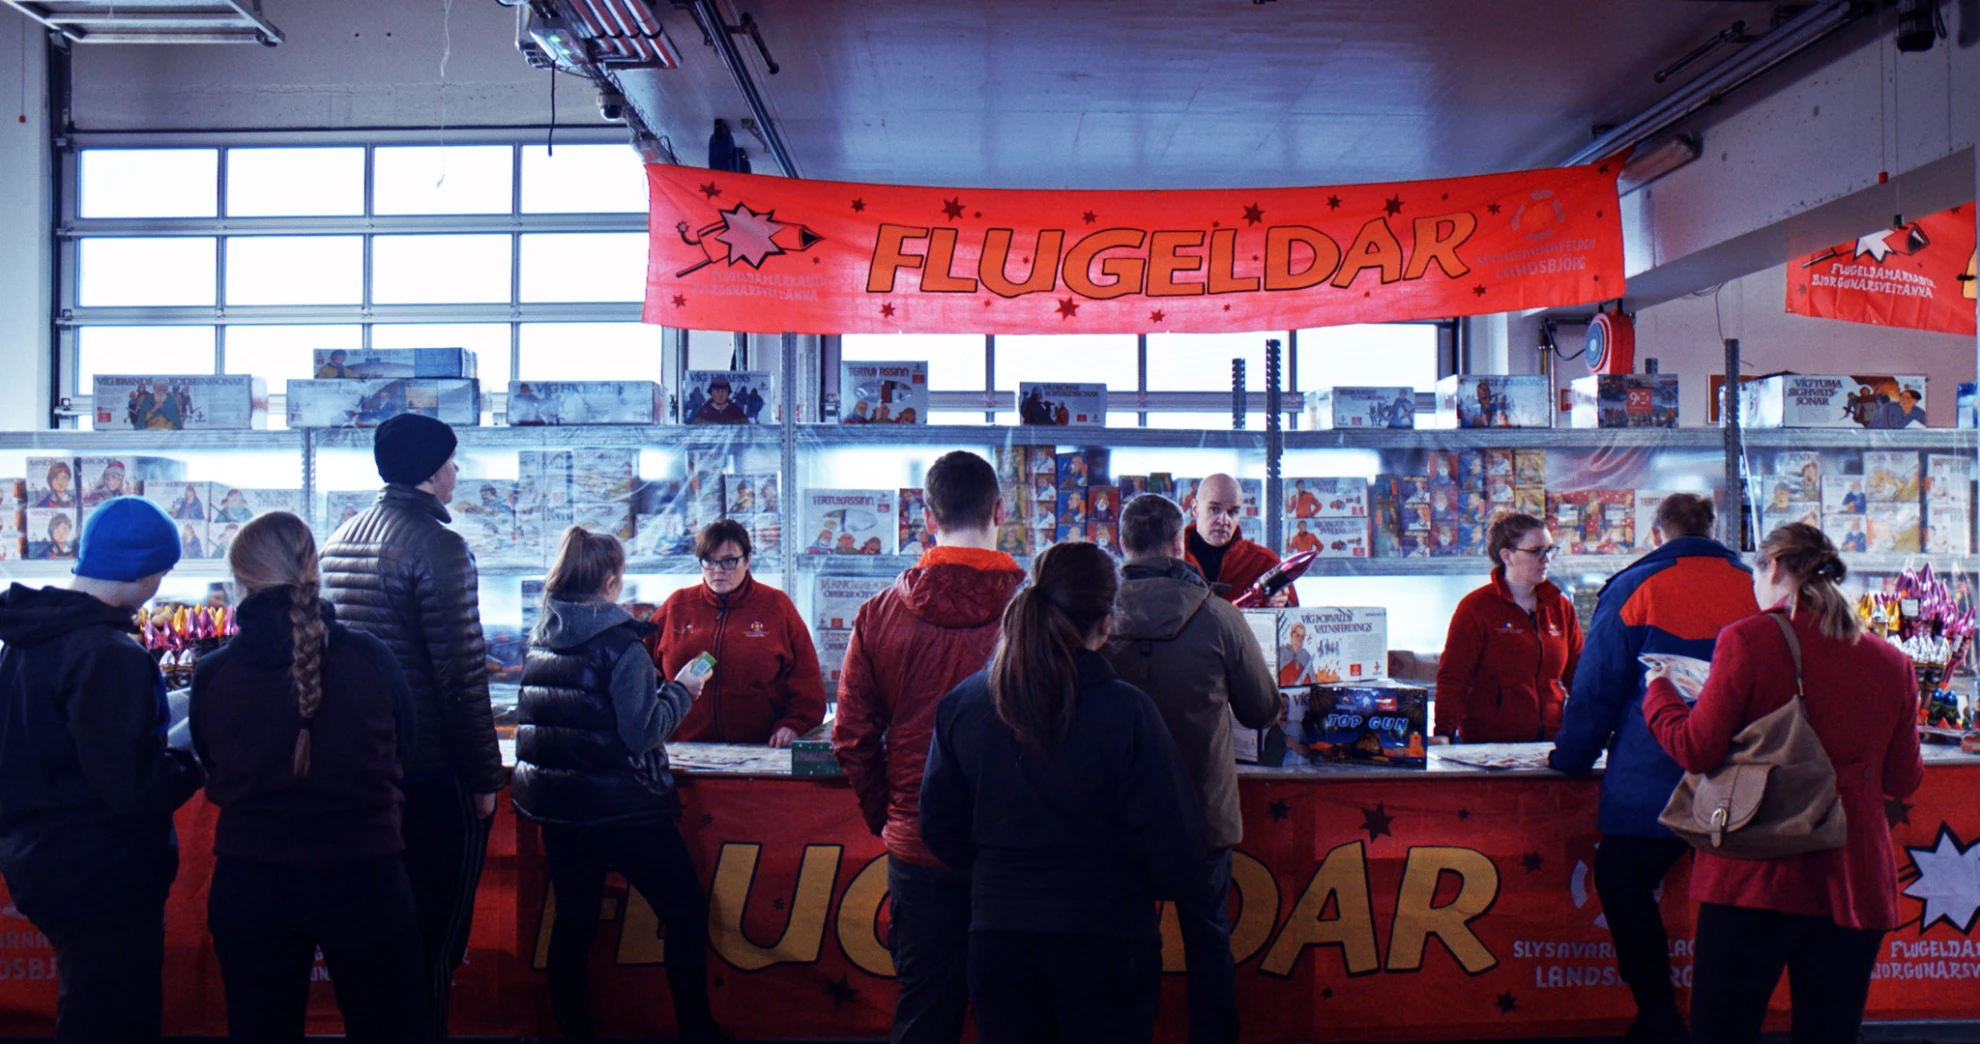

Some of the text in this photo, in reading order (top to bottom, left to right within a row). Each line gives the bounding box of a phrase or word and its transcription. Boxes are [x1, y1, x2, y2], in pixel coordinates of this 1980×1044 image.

[866, 211, 1478, 300] FLUGELDAR
[1495, 254, 1586, 280] LANDSBJÖRG
[849, 367, 909, 377] TERTUASSINN
[1327, 713, 1409, 731] TOP GUN
[794, 752, 837, 761] TRAUST
[1890, 940, 1980, 958] FLUGELDA
